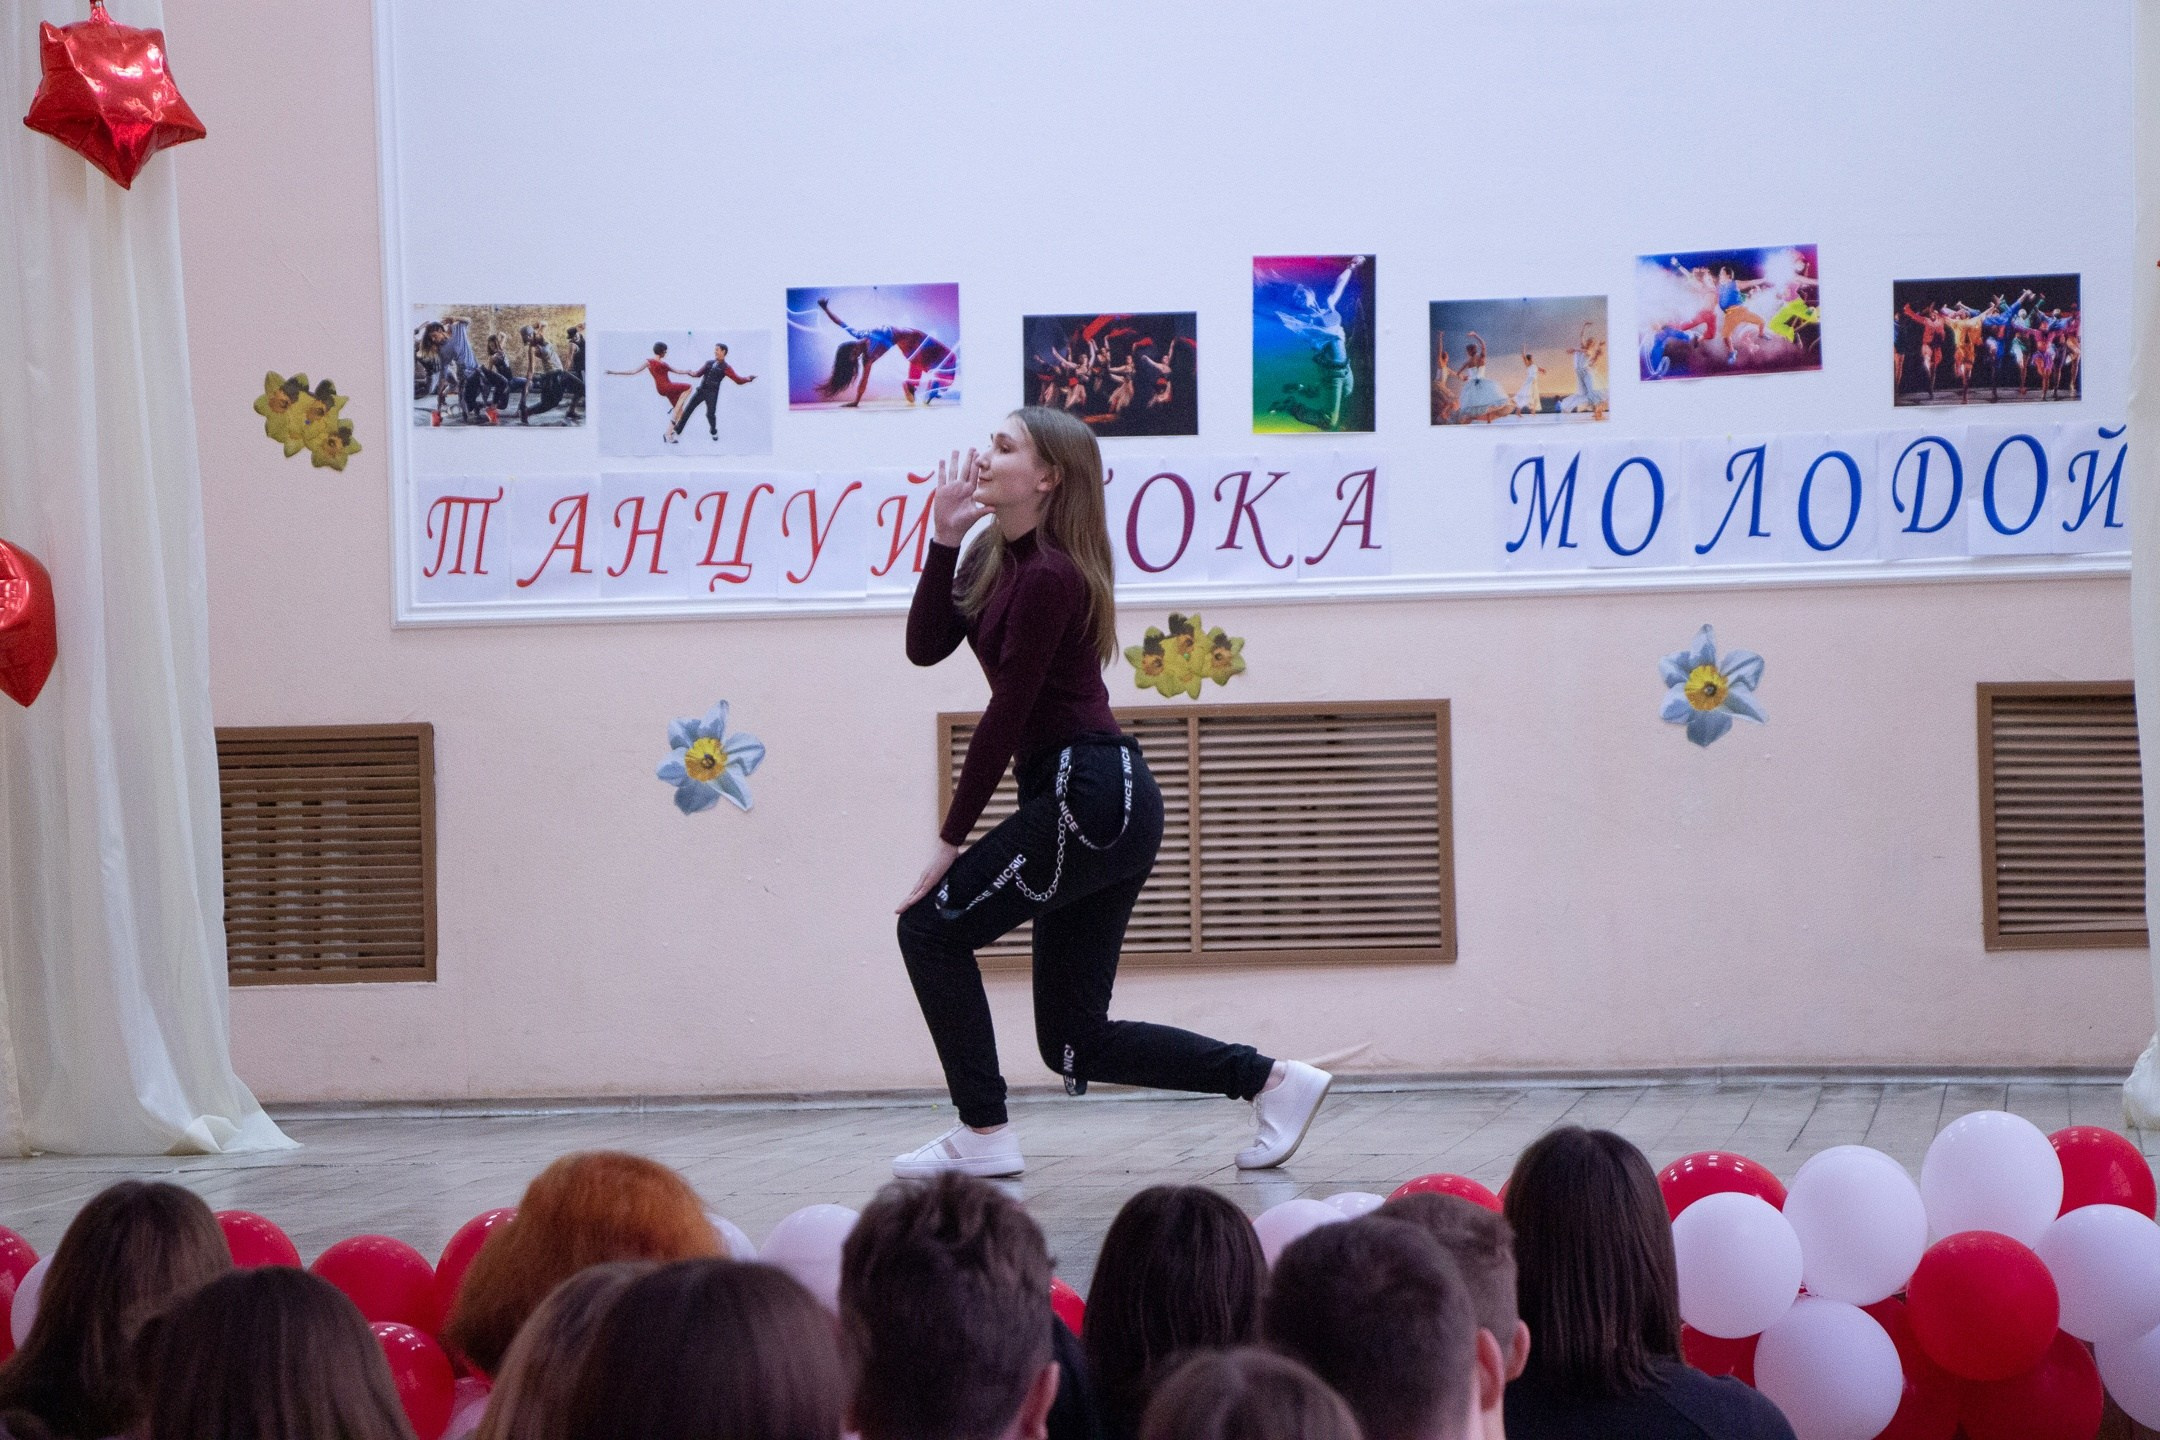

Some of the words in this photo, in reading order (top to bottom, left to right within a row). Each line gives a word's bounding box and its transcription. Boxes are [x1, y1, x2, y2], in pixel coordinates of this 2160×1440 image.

[423, 470, 937, 592] ТАНЦУЙ
[1104, 467, 1382, 574] ОКА
[1505, 424, 2128, 557] МОЛОДОЙ
[1120, 745, 1133, 774] NICE
[1125, 778, 1133, 811] NICE
[1059, 800, 1079, 832] NICE
[992, 868, 1014, 889] NIC
